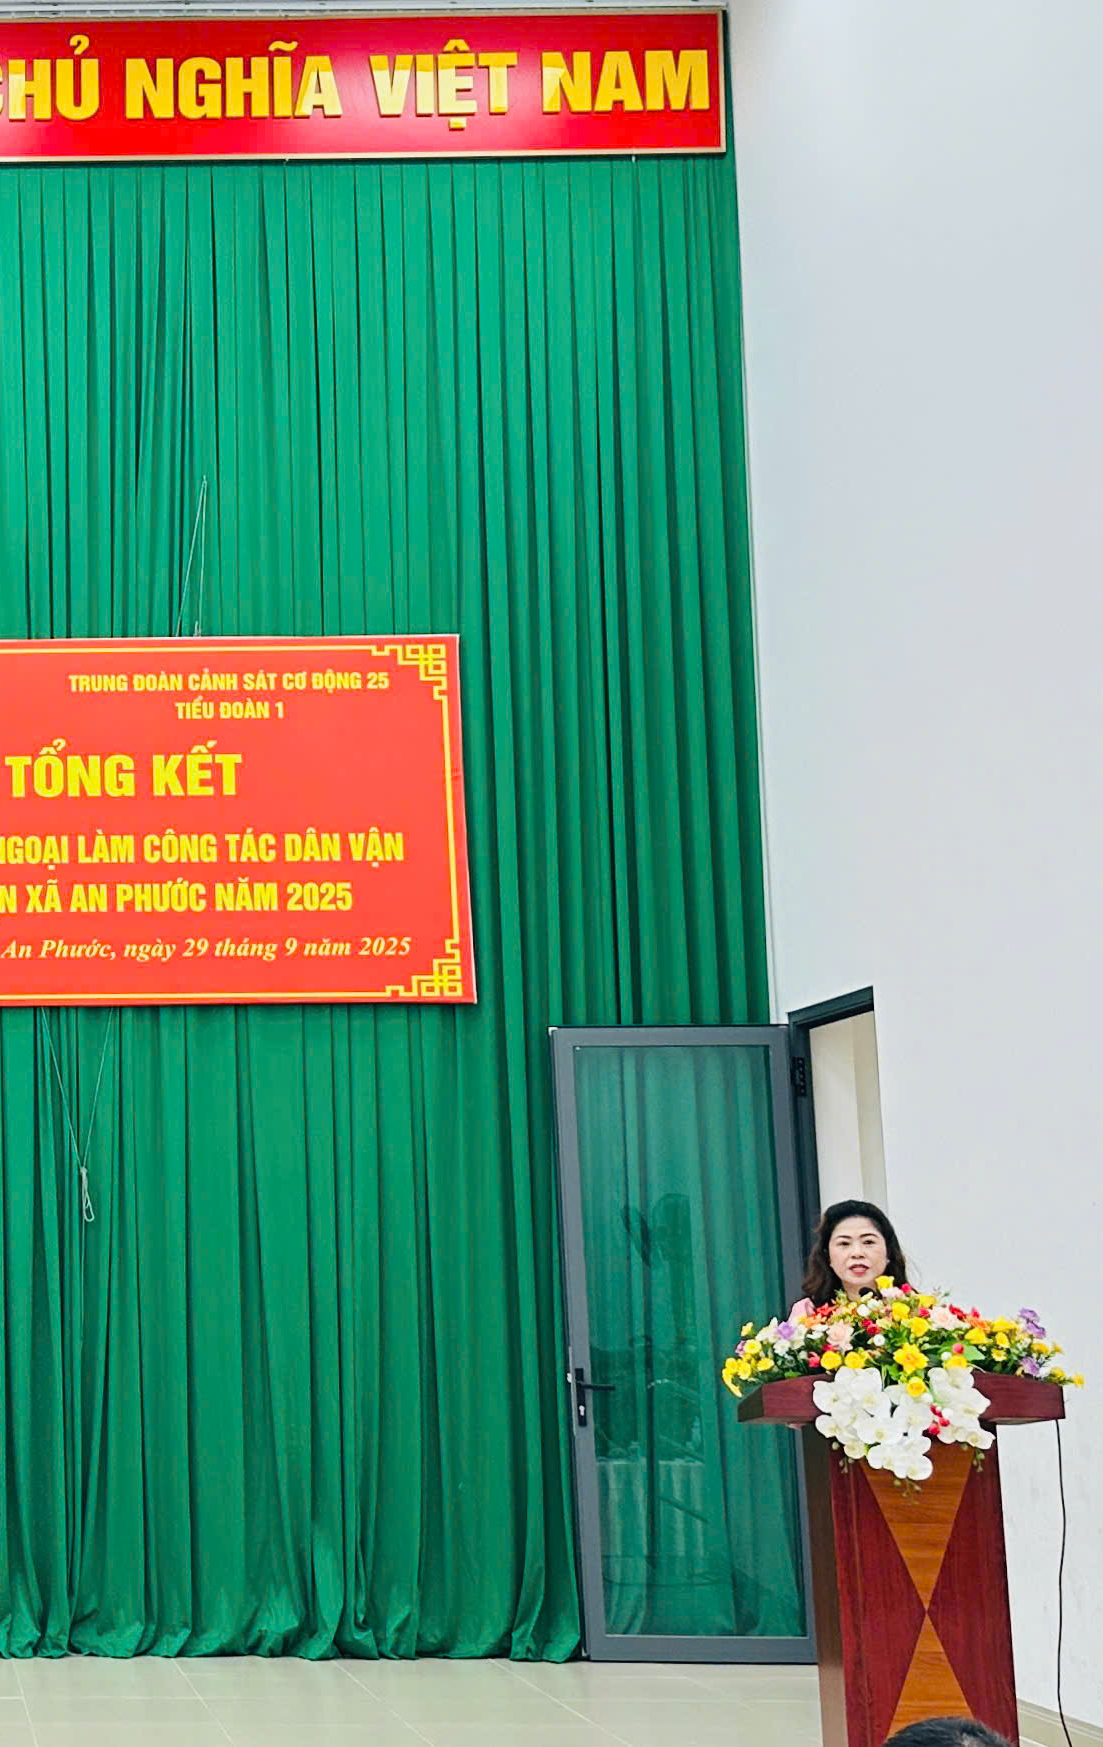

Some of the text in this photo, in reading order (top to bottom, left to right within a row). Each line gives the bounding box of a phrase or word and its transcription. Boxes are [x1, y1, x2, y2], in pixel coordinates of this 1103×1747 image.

[125, 40, 343, 120] NGHĨA
[369, 38, 519, 129] VIỆT
[541, 49, 711, 113] NAM
[68, 667, 390, 694] TRUNG ĐOÀN CẢNH SÁT CƠ ĐỘNG 25
[218, 697, 270, 719] ĐOÀN
[274, 701, 284, 719] 1
[4, 738, 136, 798] TỔNG
[152, 739, 243, 797] KẾT
[77, 829, 135, 864] LÀM
[143, 828, 218, 864] CÔNG
[224, 827, 277, 863] TÁC
[284, 827, 342, 862] DÂN
[348, 826, 405, 868] VẬN
[25, 878, 63, 913] XÃ
[69, 883, 108, 913] AN
[116, 877, 207, 913] PHƯỚC
[214, 876, 279, 912] NĂM
[286, 881, 353, 912] 2025
[0, 936, 412, 962] An Phước, ngày 29 tháng 9 năm 2025
